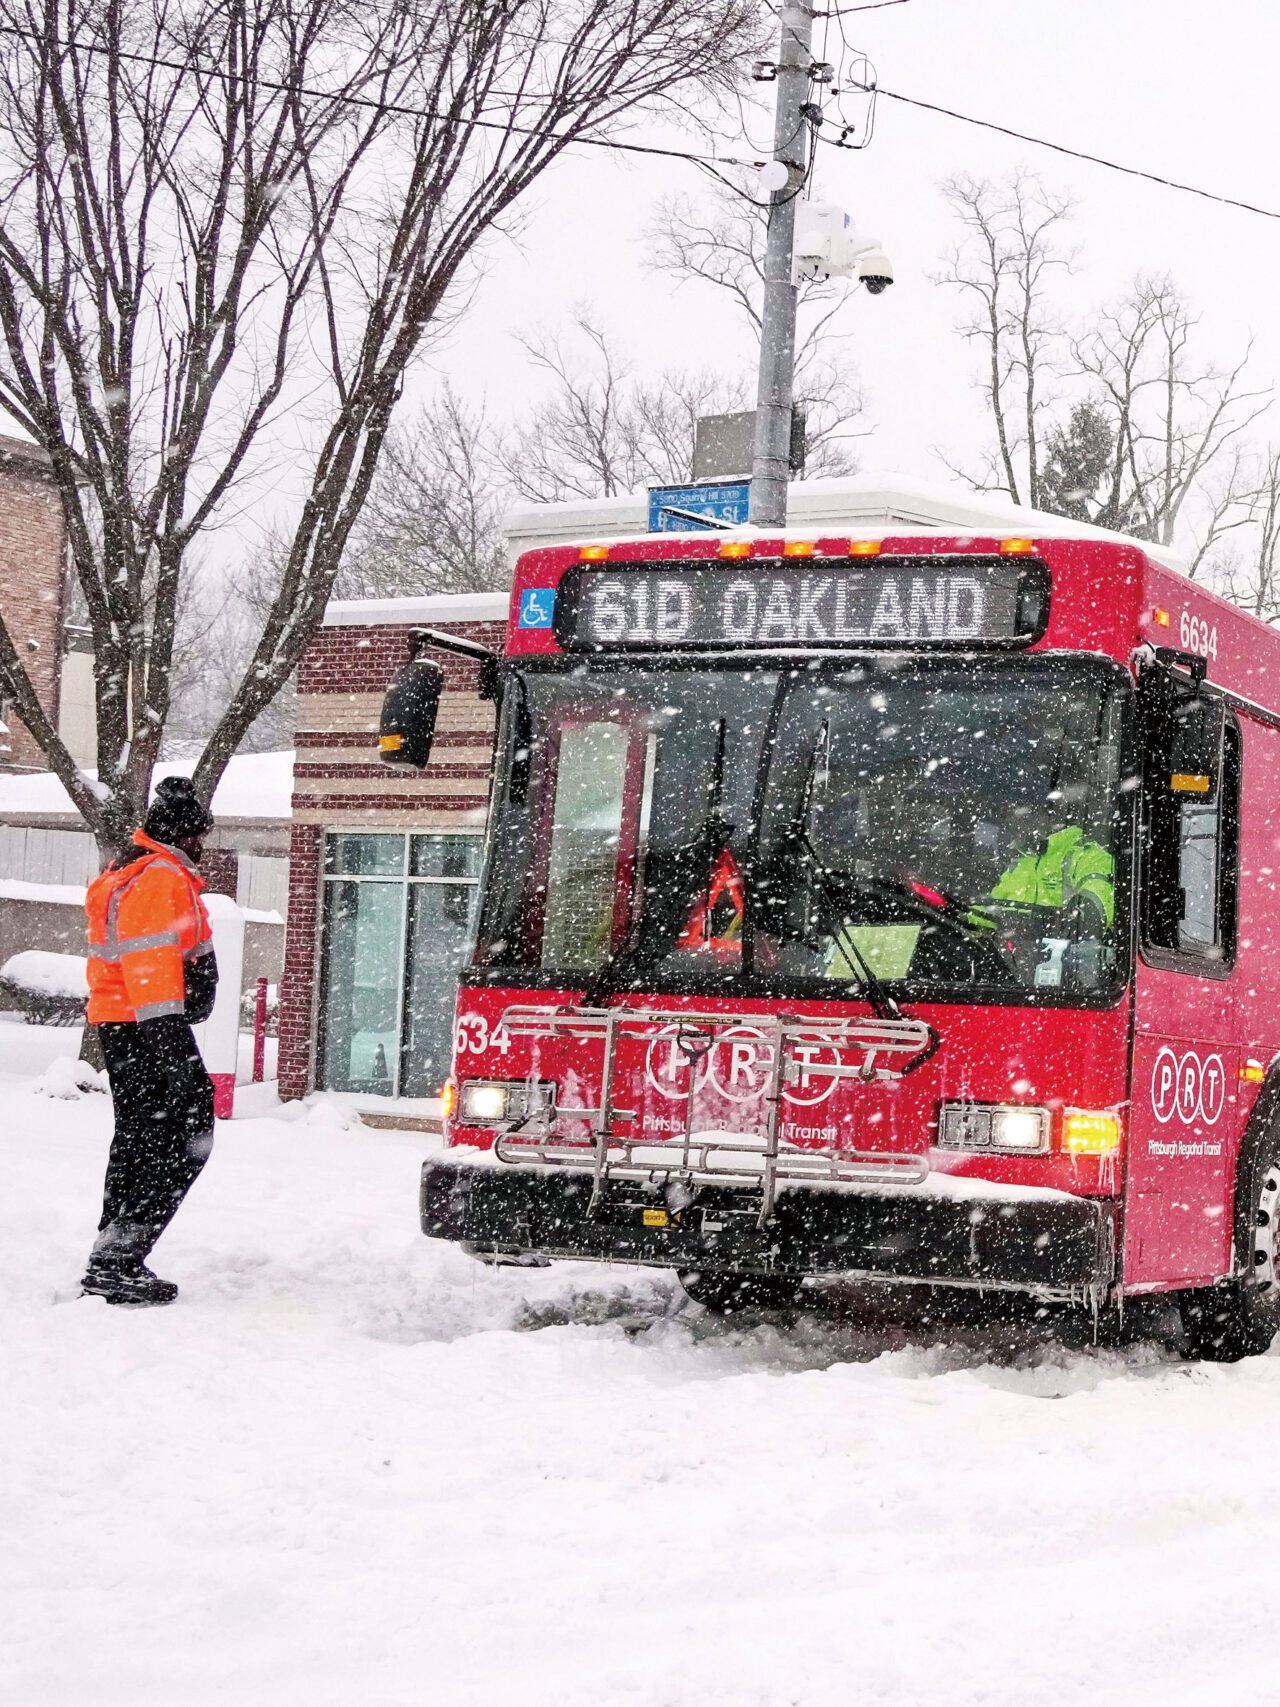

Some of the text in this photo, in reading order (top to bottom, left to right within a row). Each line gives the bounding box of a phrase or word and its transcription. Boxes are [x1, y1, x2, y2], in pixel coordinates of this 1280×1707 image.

[722, 506, 739, 523] St
[593, 577, 985, 640] 61D OAKLAND
[1180, 611, 1218, 662] 6634
[664, 1033, 823, 1091] PRT
[1156, 1061, 1220, 1111] PRT
[789, 1124, 837, 1140] Transit
[1148, 1140, 1221, 1159] Pittsburgh Regional Transit
